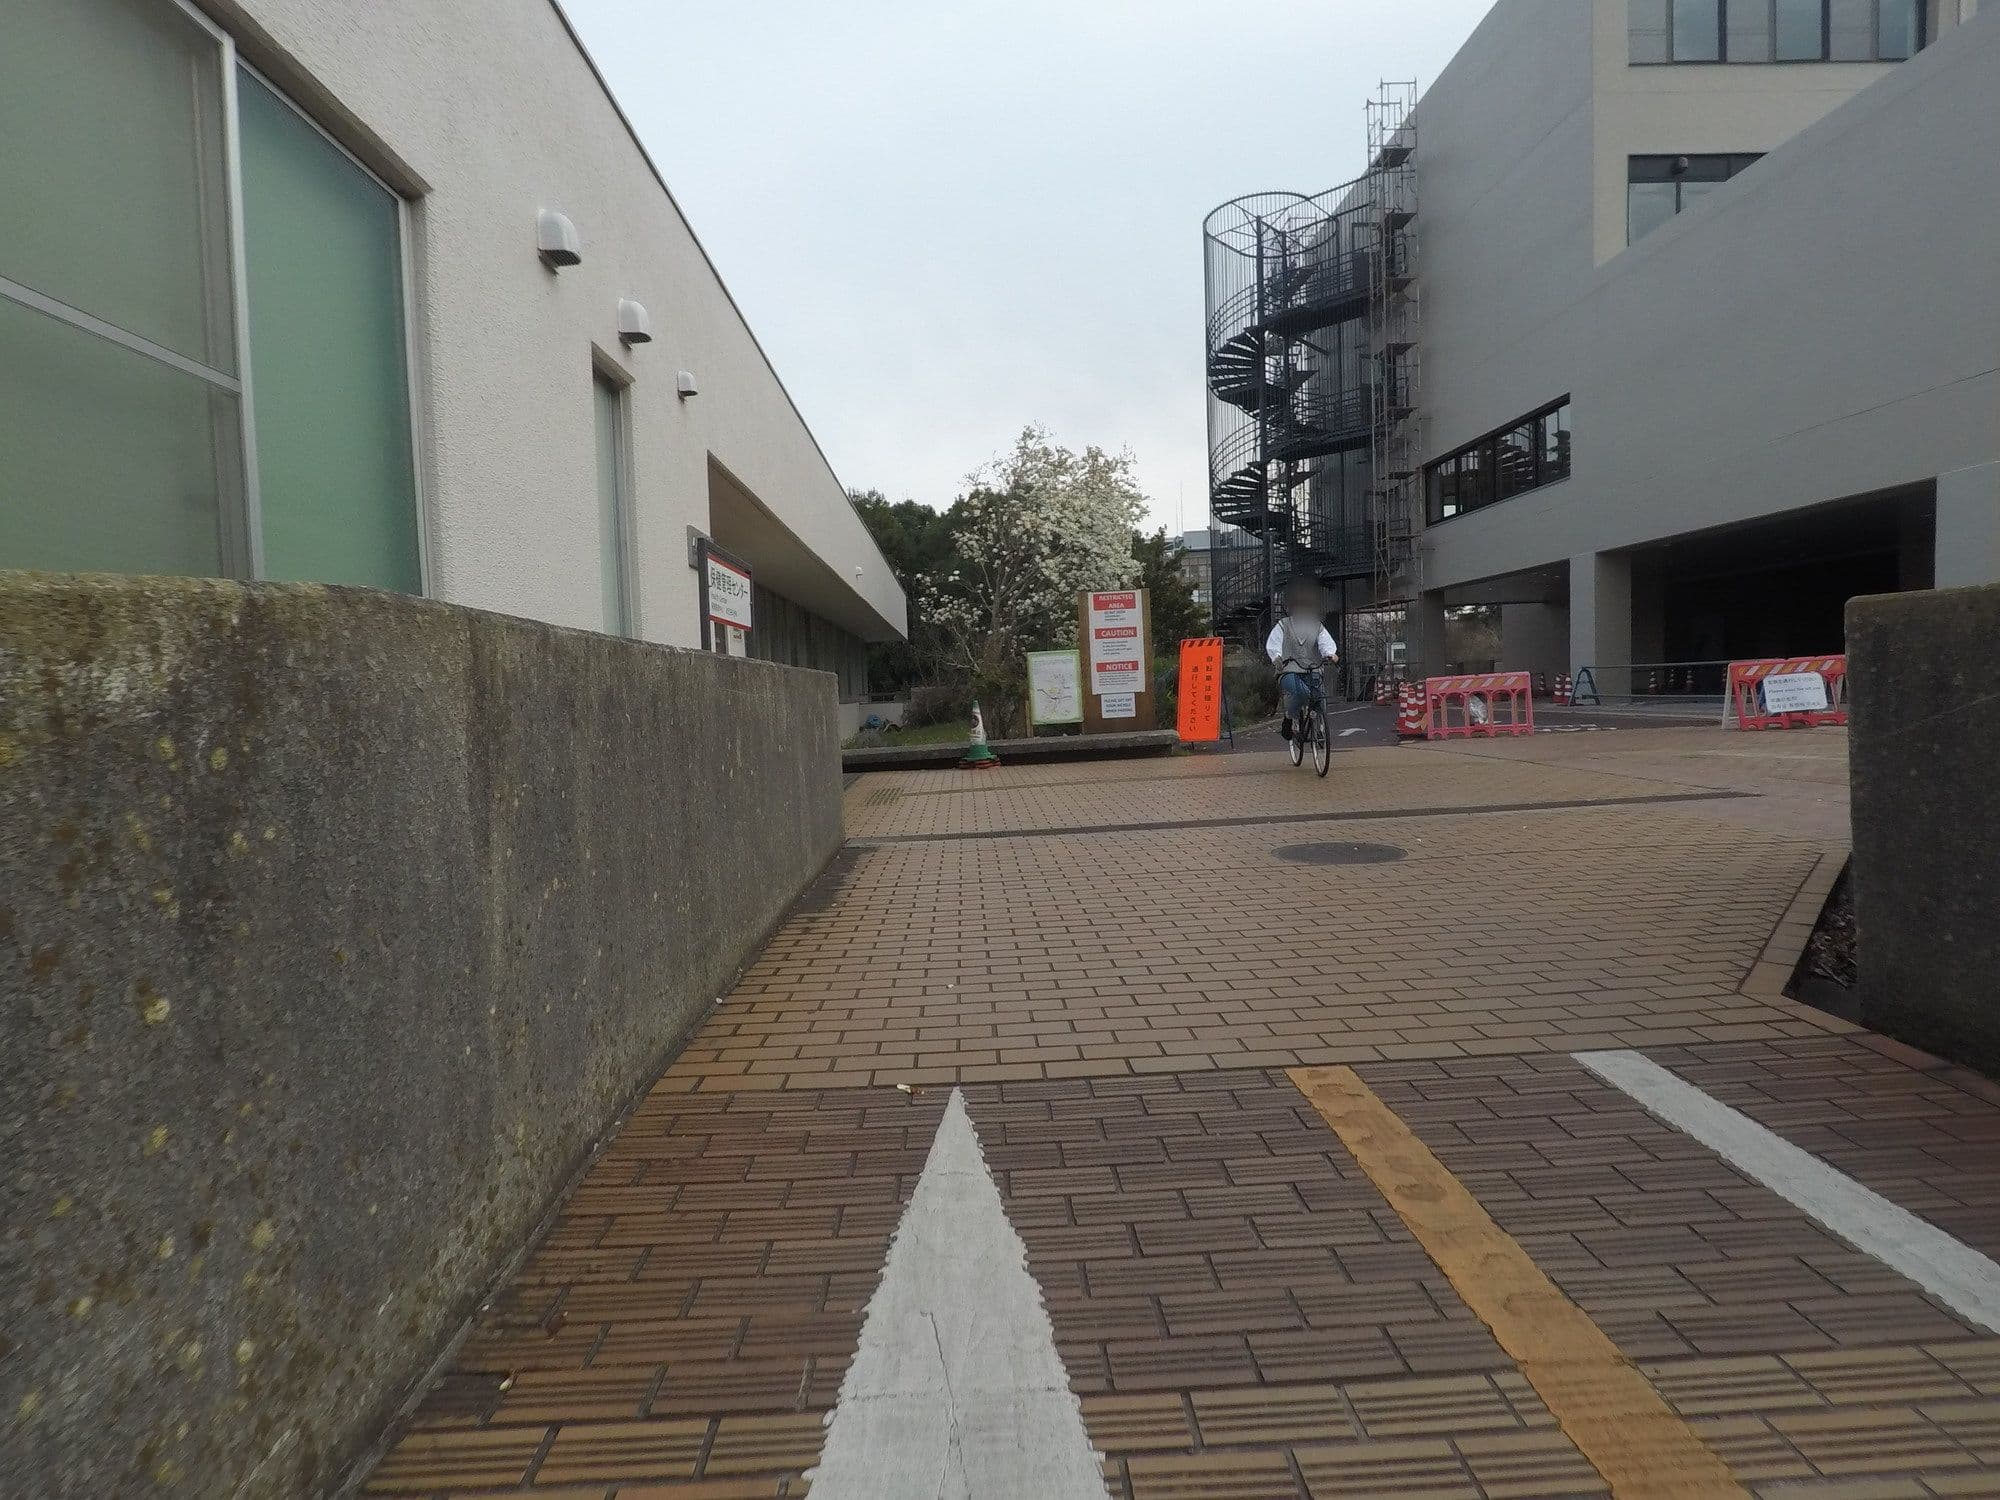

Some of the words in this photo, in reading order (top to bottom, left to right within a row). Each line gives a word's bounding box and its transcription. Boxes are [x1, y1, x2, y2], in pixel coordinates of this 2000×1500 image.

[1098, 593, 1133, 601] RESTRICTED
[1101, 628, 1135, 637] CAUTION
[1105, 663, 1133, 671] NOTICE
[1189, 664, 1199, 731] 通行してください
